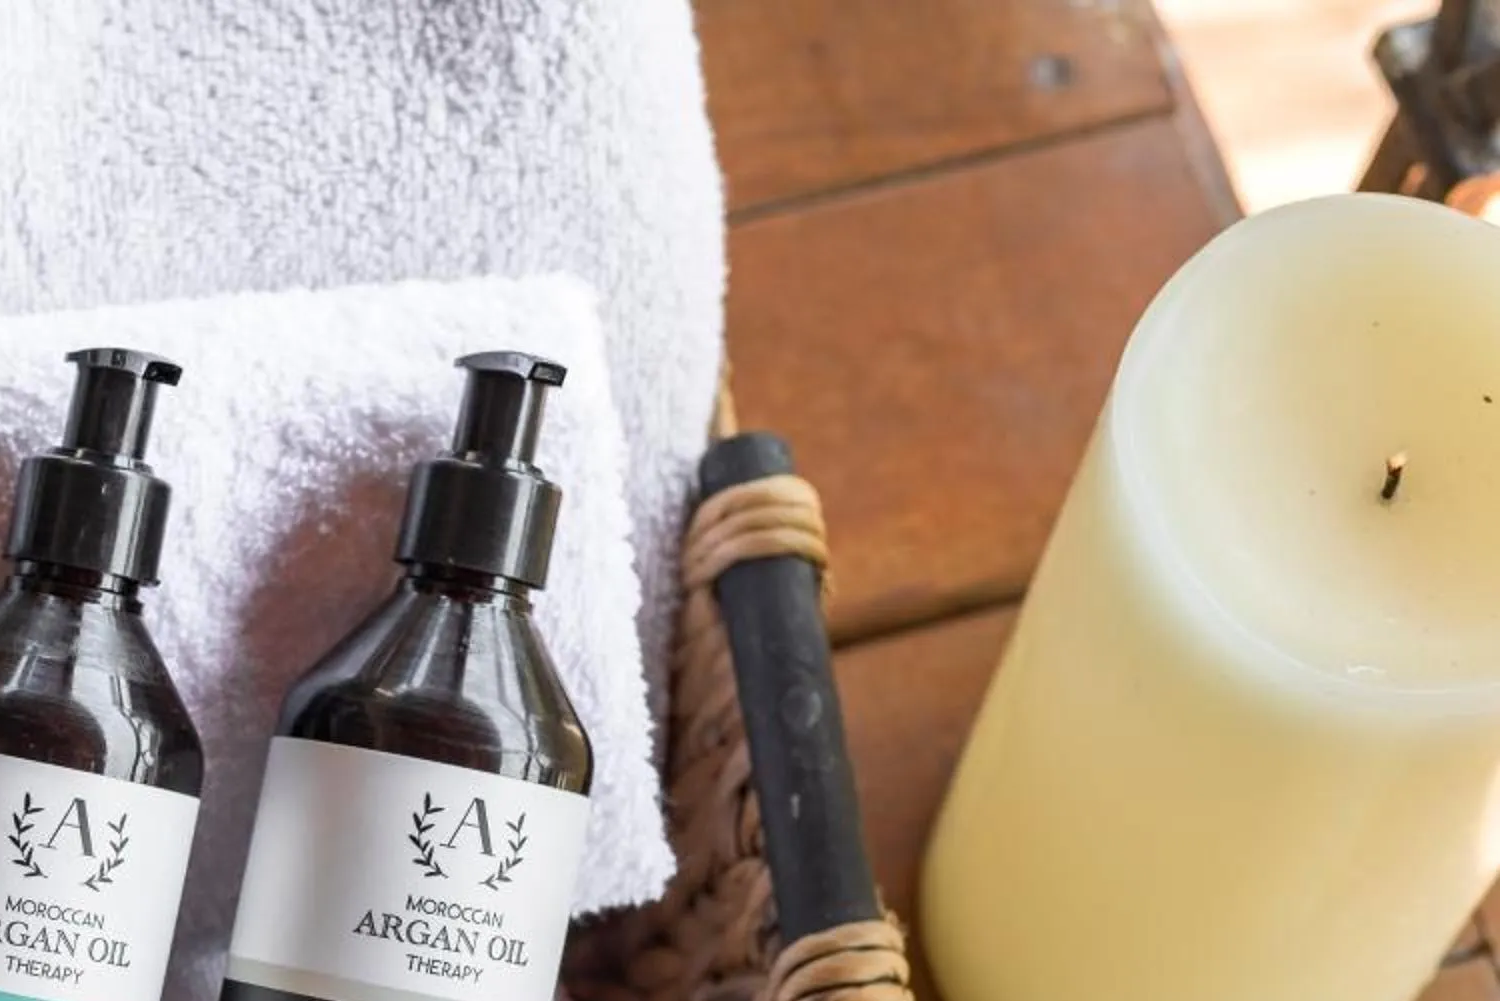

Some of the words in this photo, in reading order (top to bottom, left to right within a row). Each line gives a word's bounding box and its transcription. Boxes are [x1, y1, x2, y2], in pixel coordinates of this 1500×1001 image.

[38, 797, 98, 857] A
[438, 797, 498, 857] A
[5, 895, 105, 930] MOROCCAN
[405, 894, 504, 929] MOROCCAN
[89, 935, 132, 969] OIL
[352, 910, 480, 957] ARGAN
[487, 935, 530, 968] OIL
[5, 955, 86, 985] THERAPY
[405, 953, 485, 983] THERAPY
